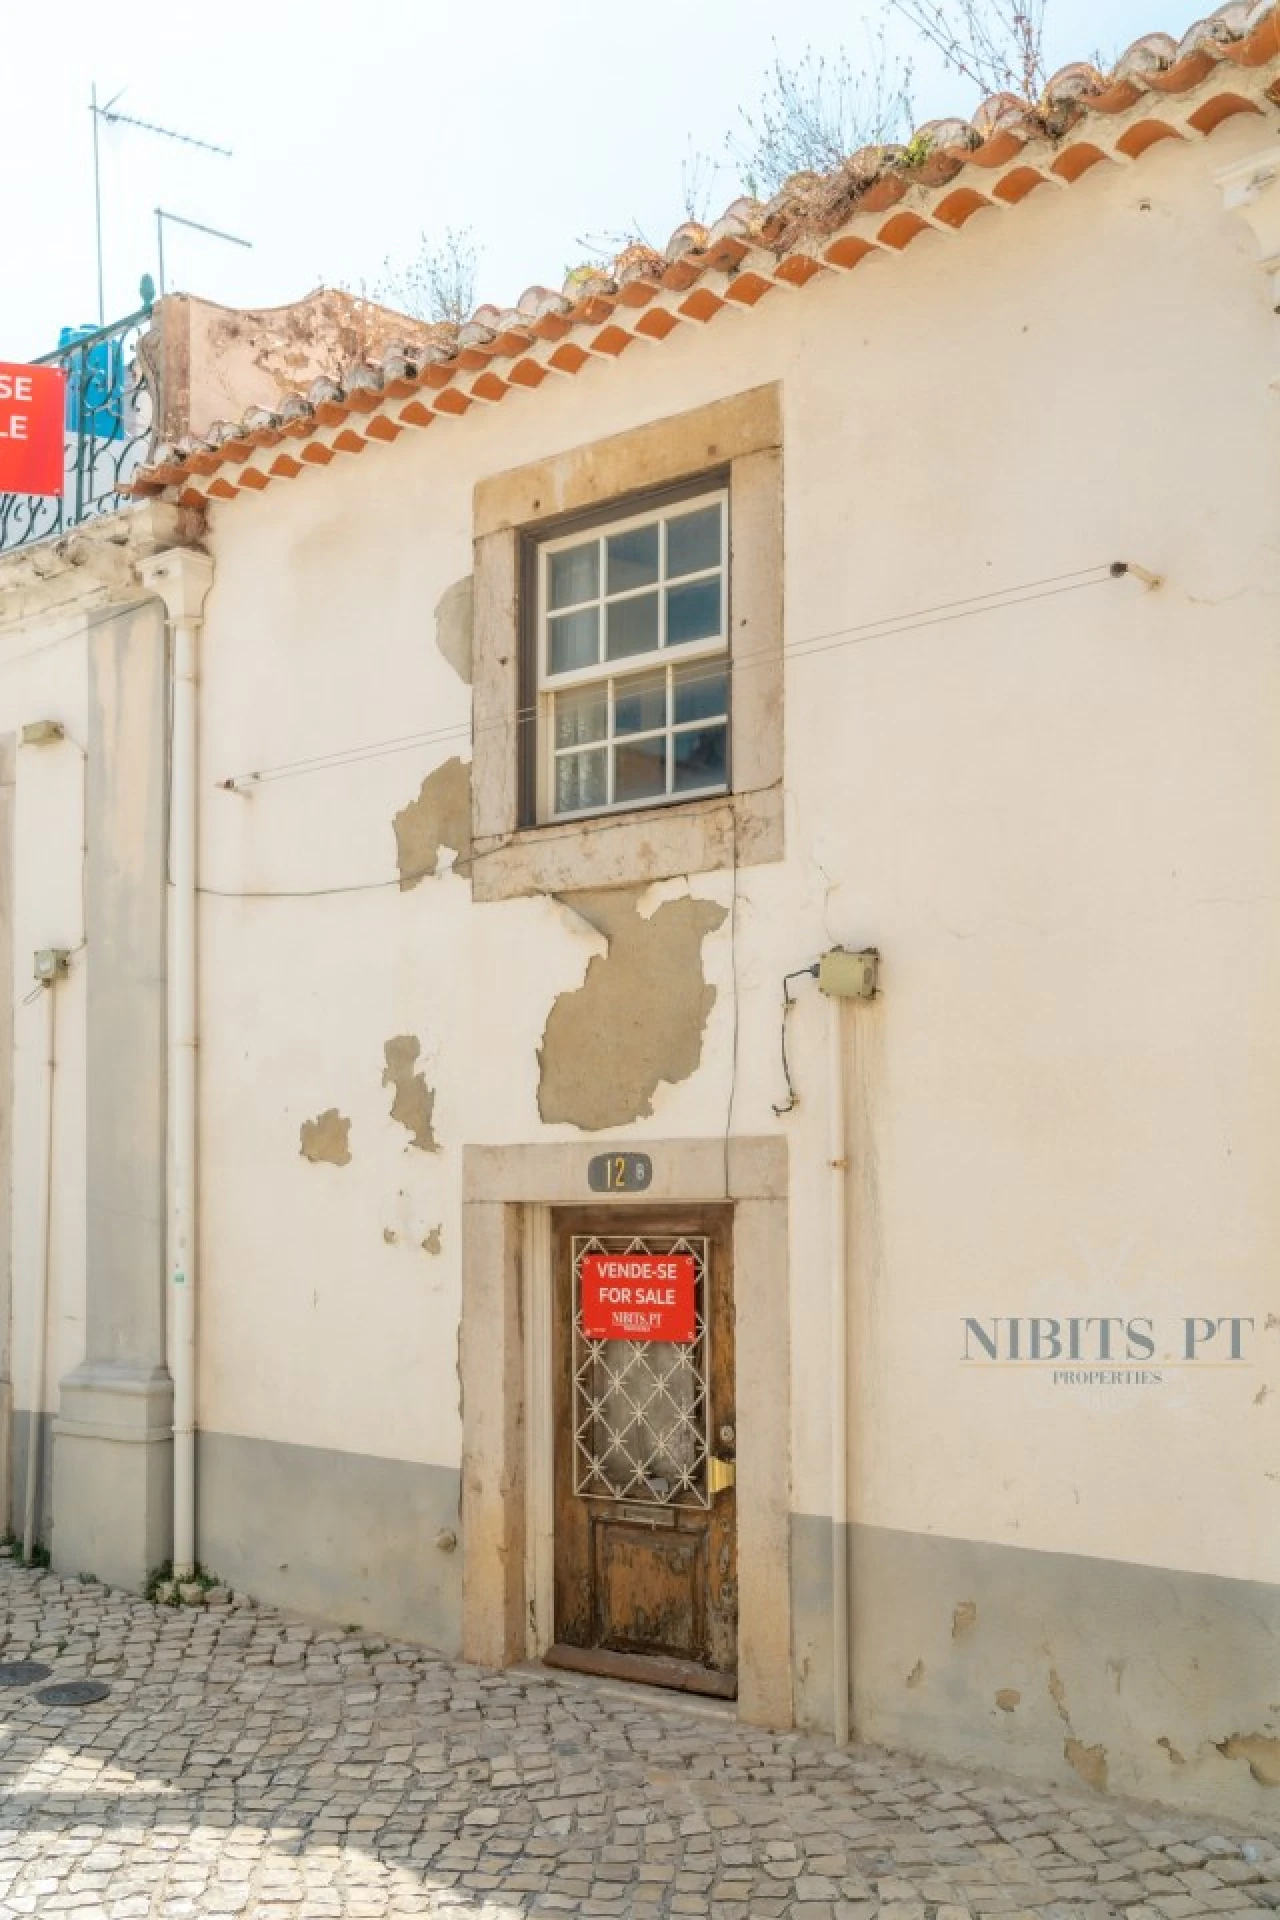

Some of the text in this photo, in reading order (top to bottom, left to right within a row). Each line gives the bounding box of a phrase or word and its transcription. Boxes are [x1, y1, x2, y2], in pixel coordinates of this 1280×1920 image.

[606, 1155, 626, 1189] 12
[597, 1262, 678, 1279] VENDE-SE
[599, 1287, 677, 1305] FOR SALE
